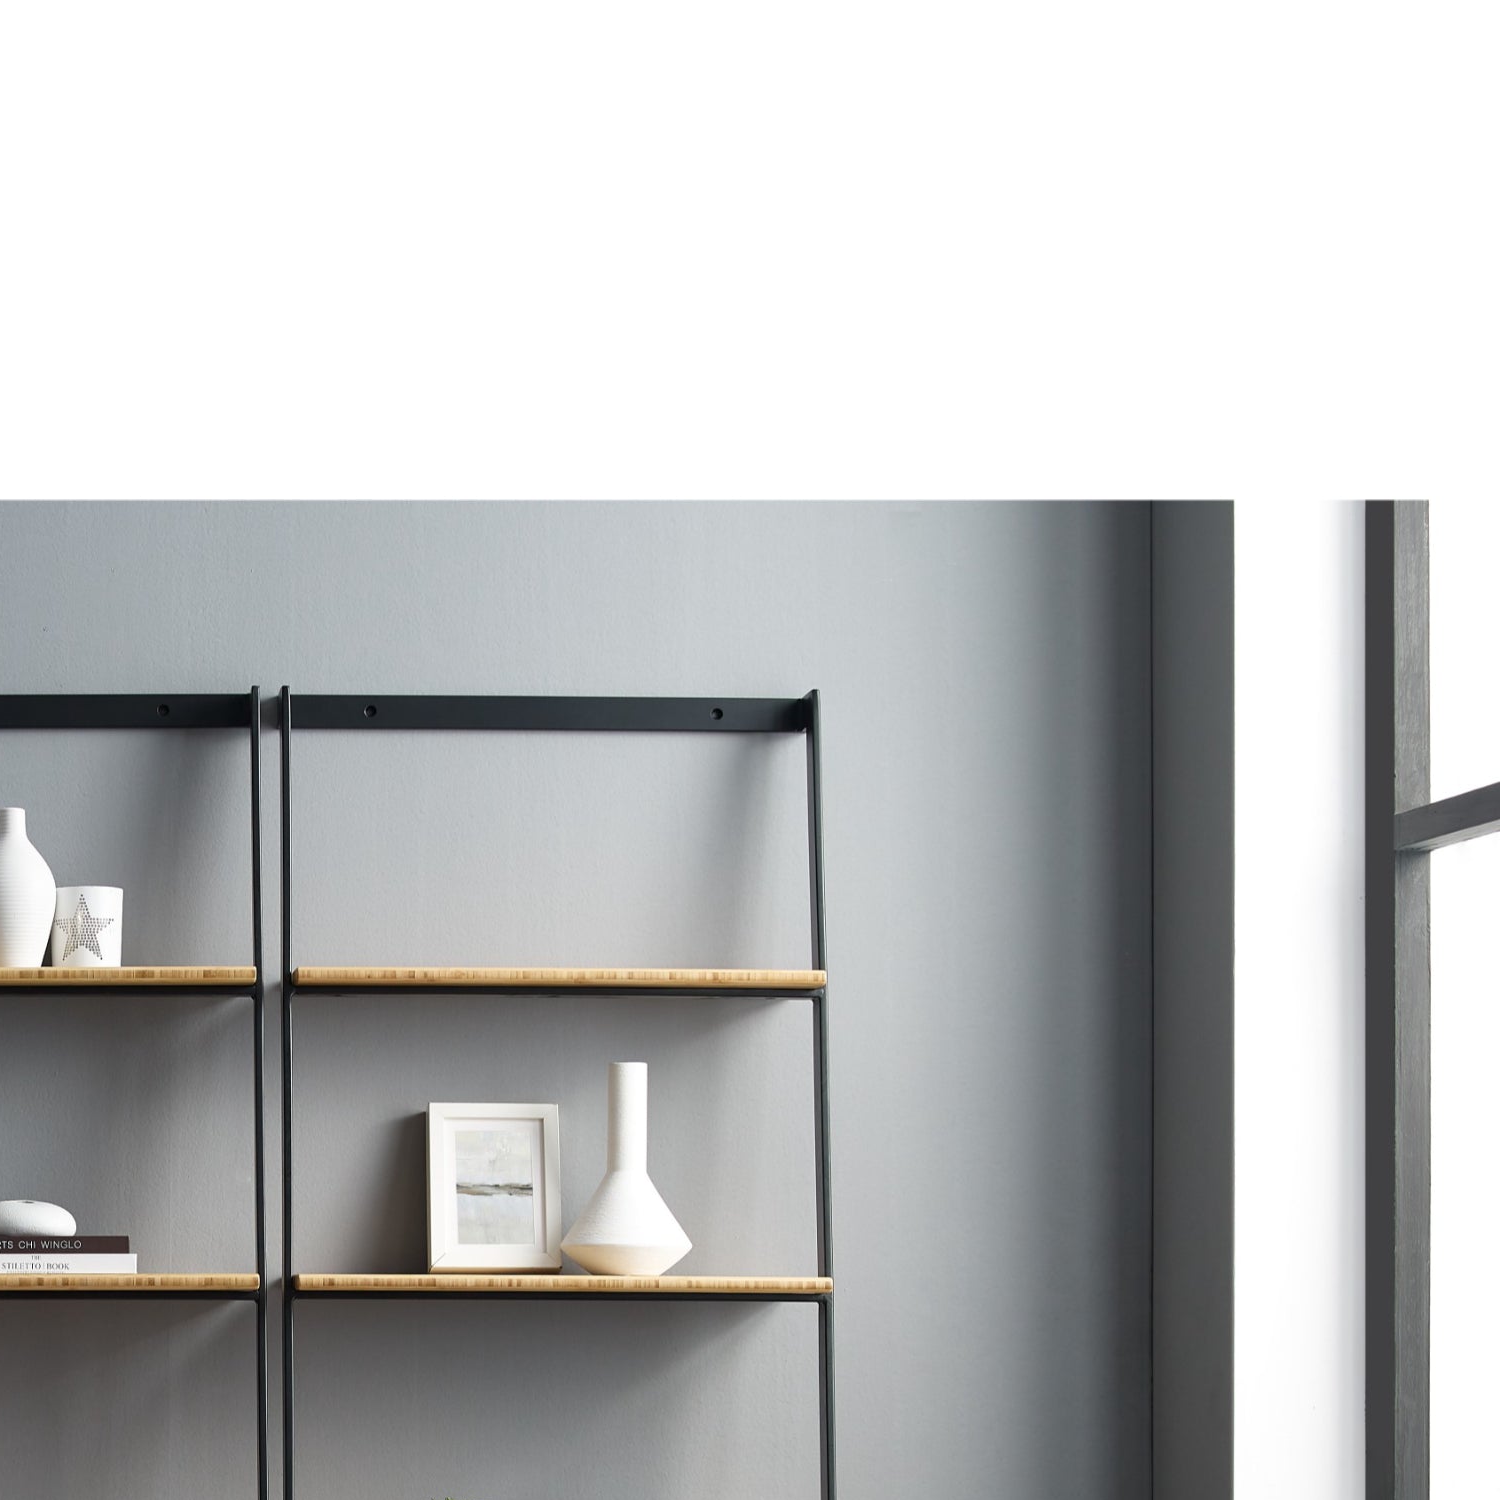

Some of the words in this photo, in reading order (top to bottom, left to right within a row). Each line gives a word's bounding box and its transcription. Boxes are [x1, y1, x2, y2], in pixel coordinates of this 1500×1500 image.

[18, 1240, 36, 1249] CHI
[41, 1240, 82, 1249] WINGLO
[46, 1262, 70, 1270] BOOK
